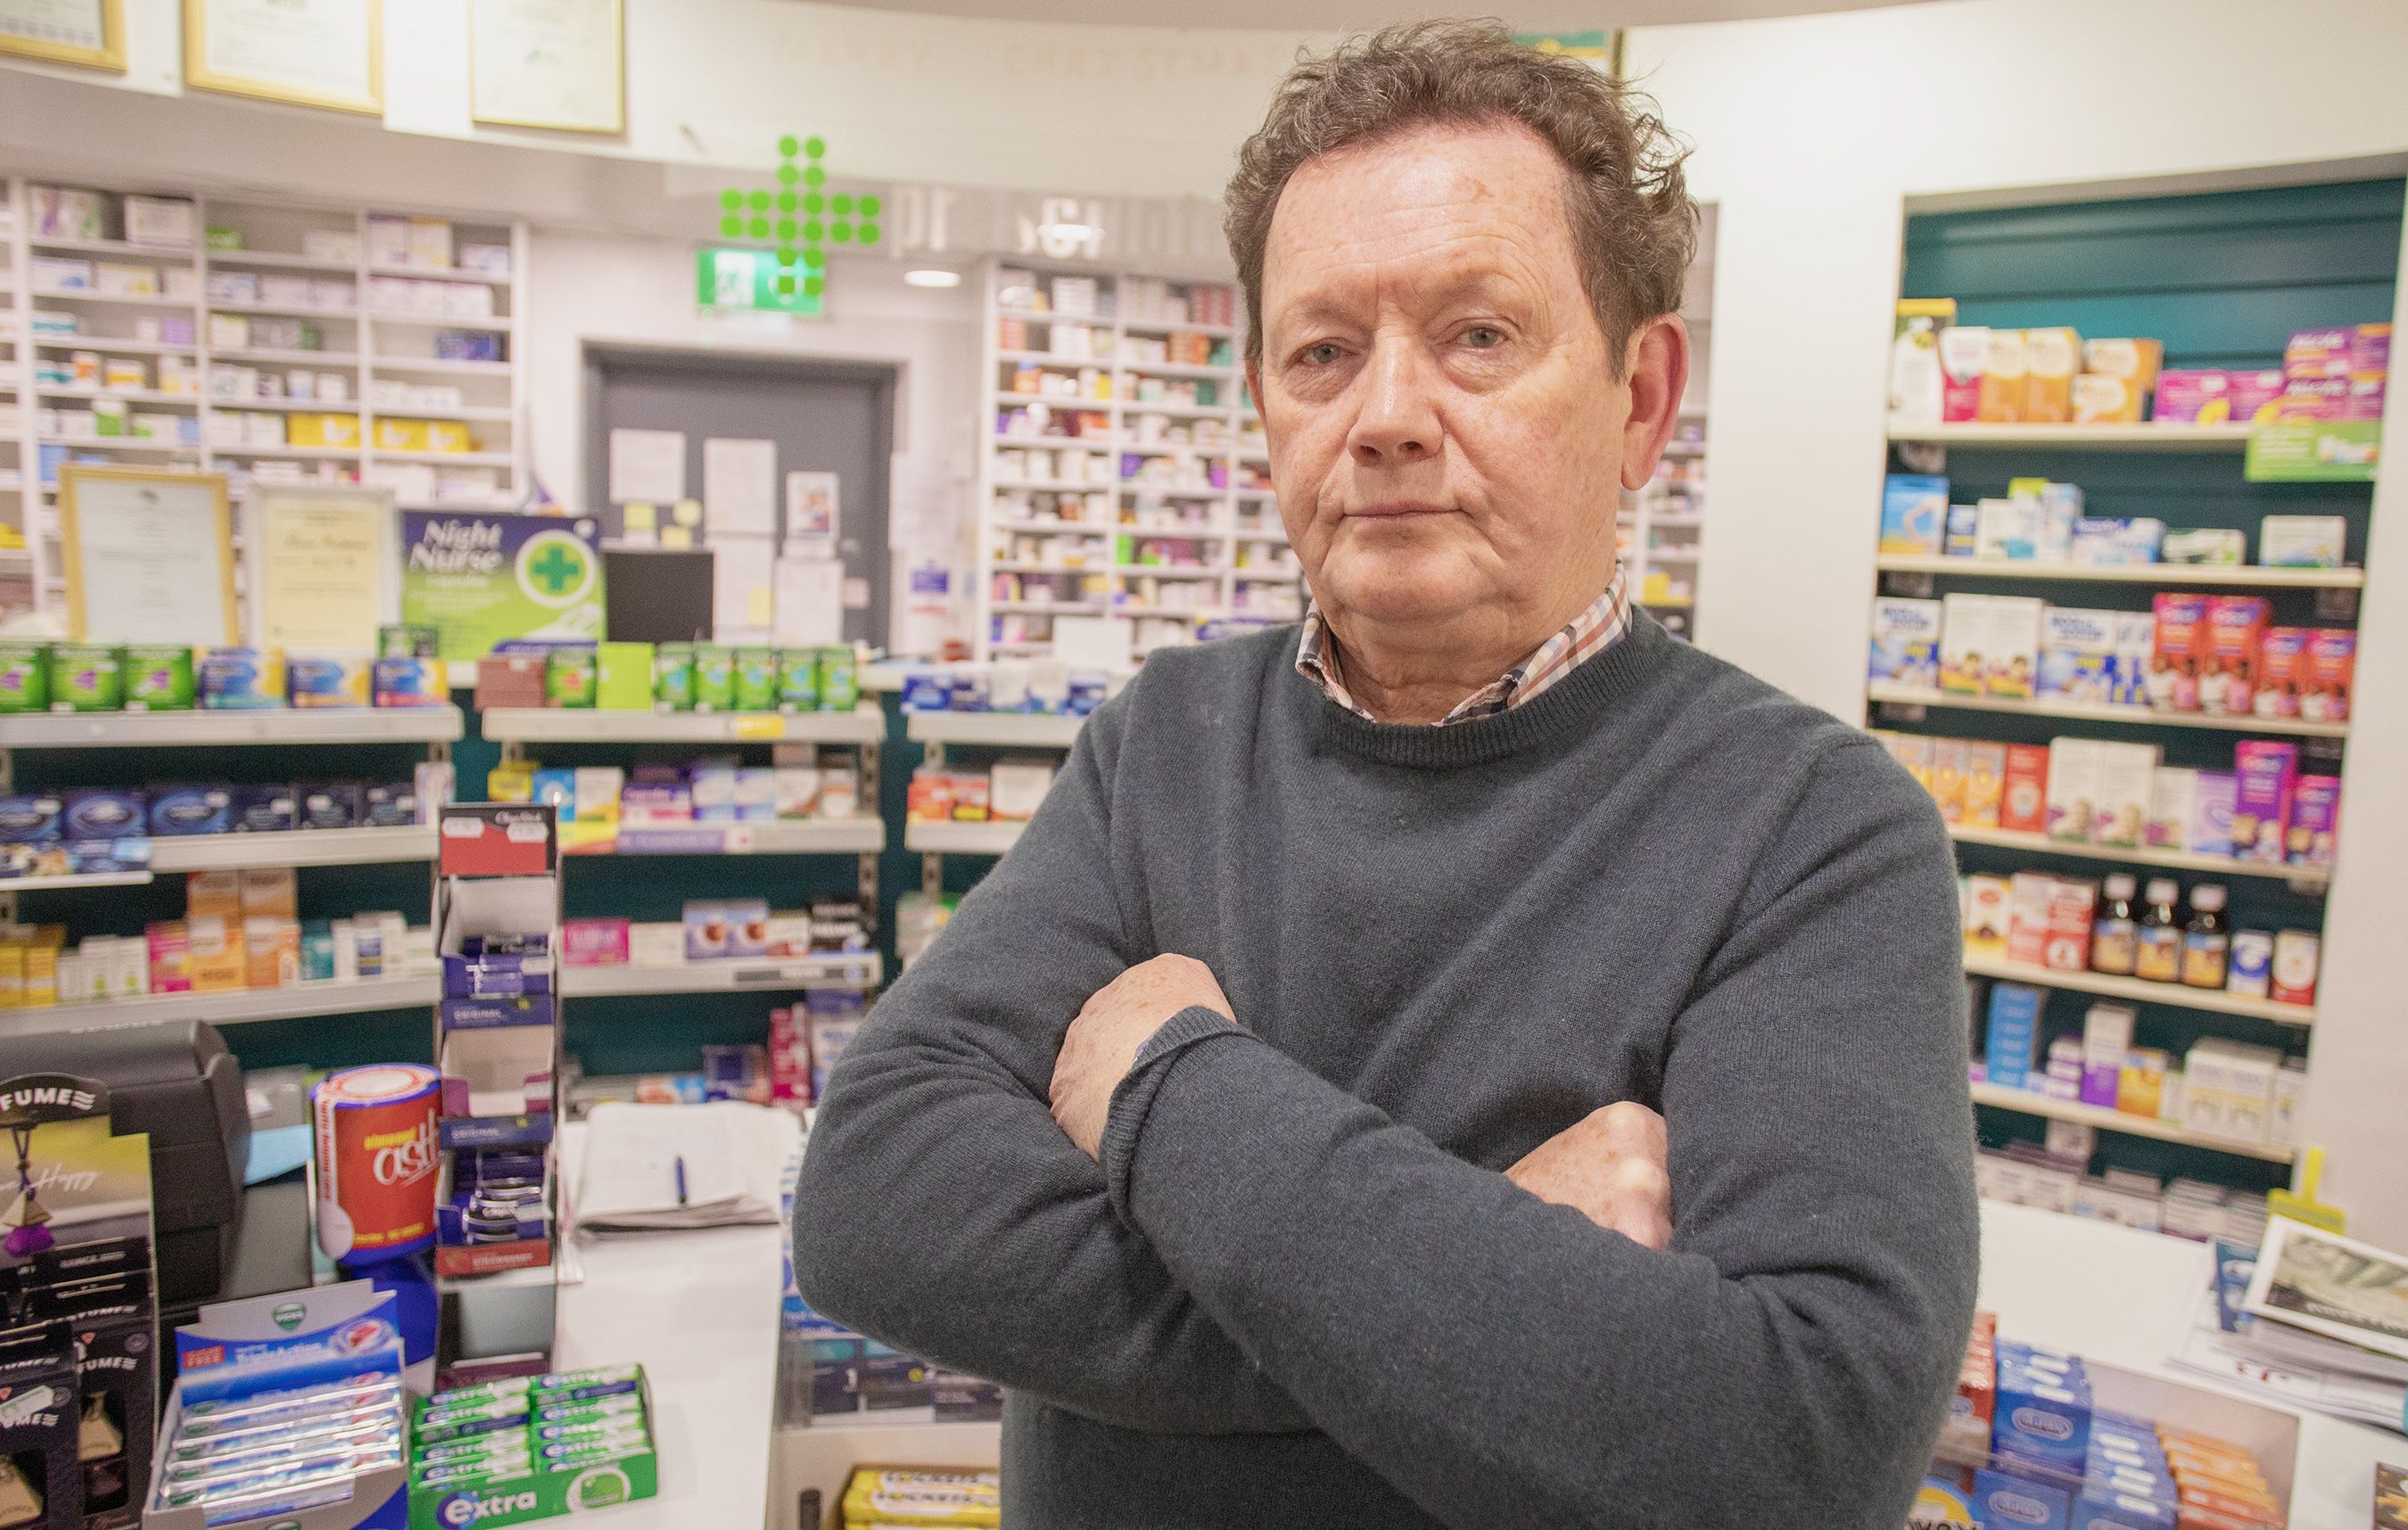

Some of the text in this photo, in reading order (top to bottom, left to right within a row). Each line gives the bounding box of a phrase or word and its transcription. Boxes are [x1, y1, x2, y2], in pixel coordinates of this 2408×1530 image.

[1002, 41, 1282, 82] CHRISTMA
[424, 519, 503, 550] Night
[409, 542, 503, 573] Nurse
[444, 1491, 537, 1526] extra
